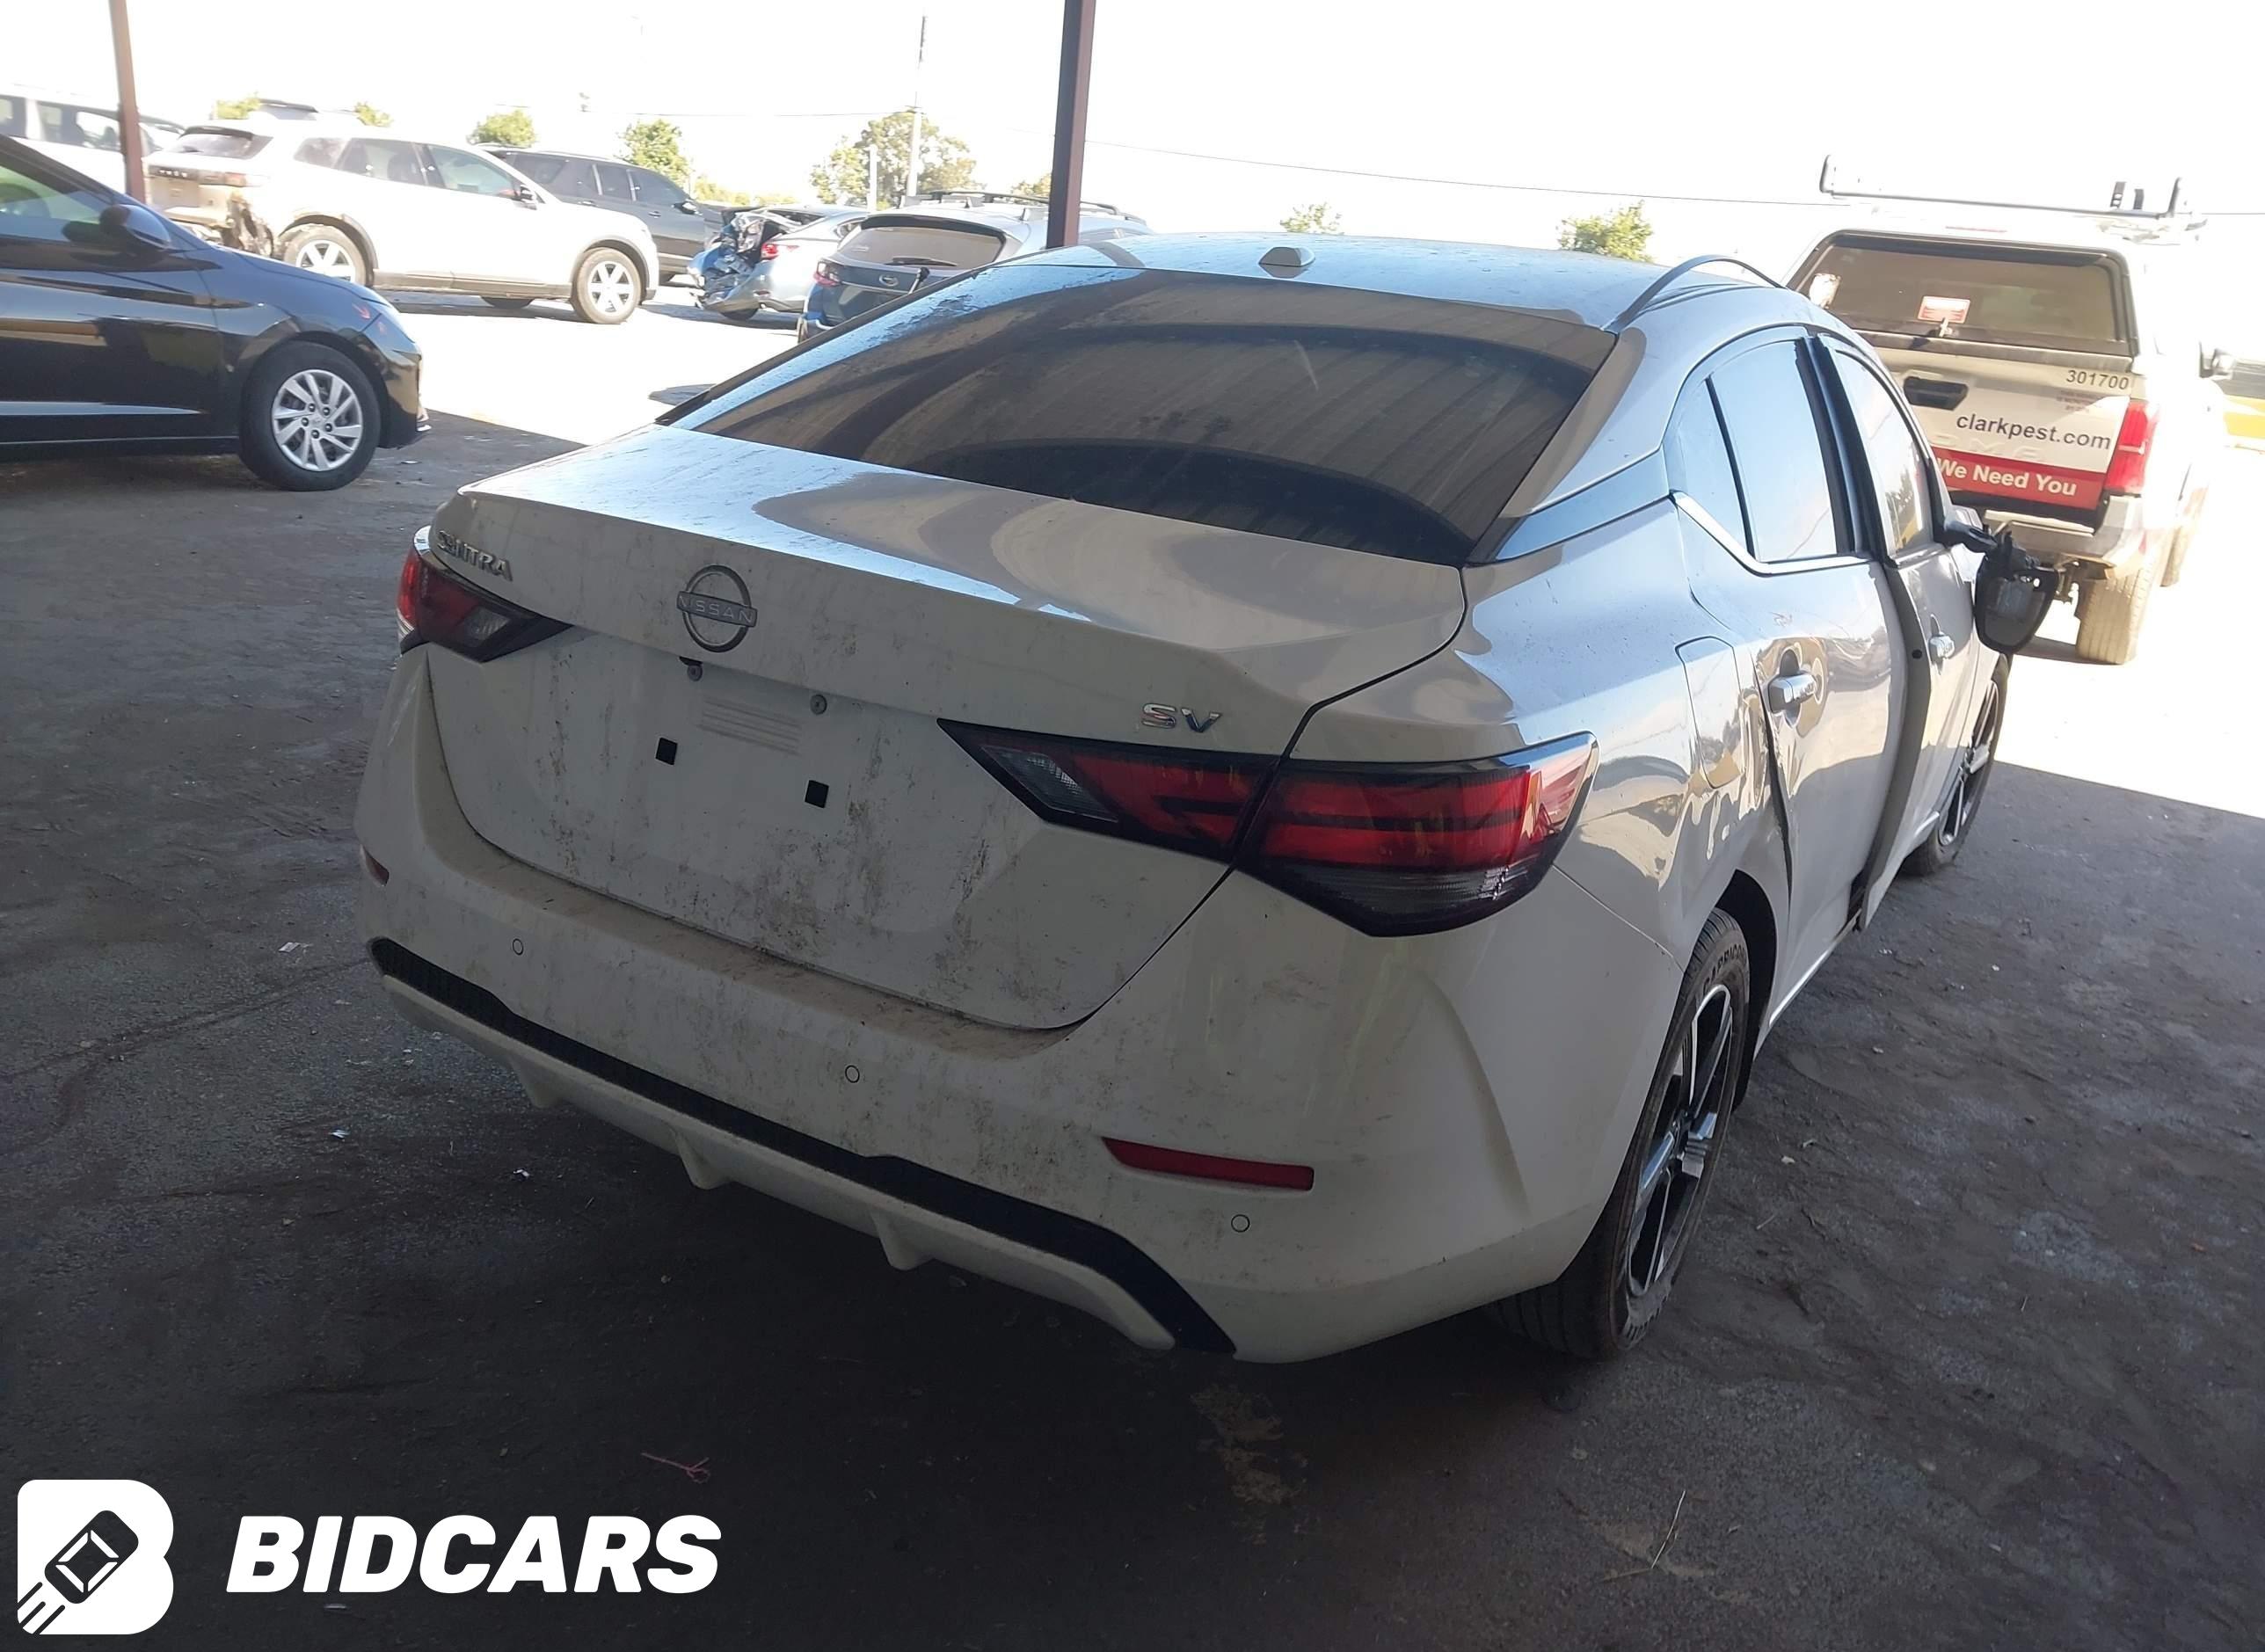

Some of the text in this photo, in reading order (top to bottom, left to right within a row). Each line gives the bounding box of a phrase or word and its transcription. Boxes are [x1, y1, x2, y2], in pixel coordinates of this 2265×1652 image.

[2066, 369, 2130, 390] 301700
[1956, 413, 2111, 450] clarkpest.com
[1938, 456, 2077, 496] We Need You
[1141, 702, 1223, 733] SV
